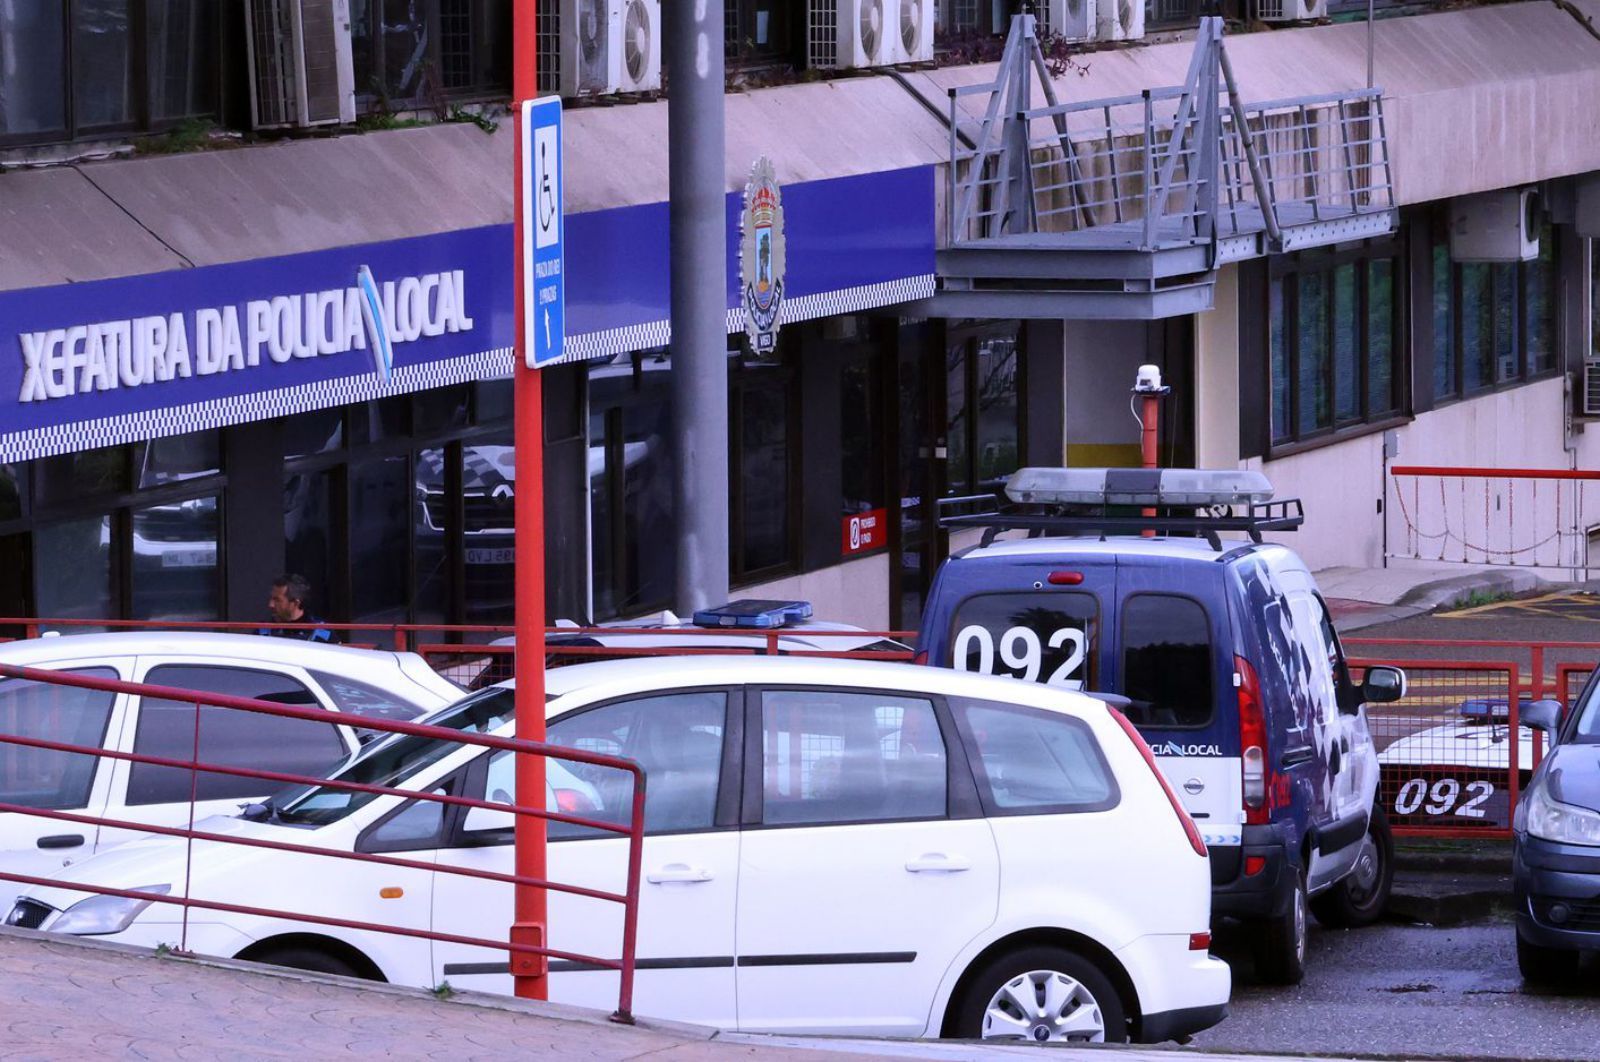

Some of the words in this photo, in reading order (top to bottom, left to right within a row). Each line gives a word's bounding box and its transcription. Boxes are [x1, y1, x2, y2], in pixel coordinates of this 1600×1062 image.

[19, 312, 192, 403] XEFATURA
[196, 305, 245, 376] DA
[247, 286, 366, 367] POLICIA
[383, 269, 474, 344] LOCAL
[953, 625, 1088, 692] 092
[1181, 743, 1223, 756] LOCAL
[1394, 778, 1494, 818] 092
